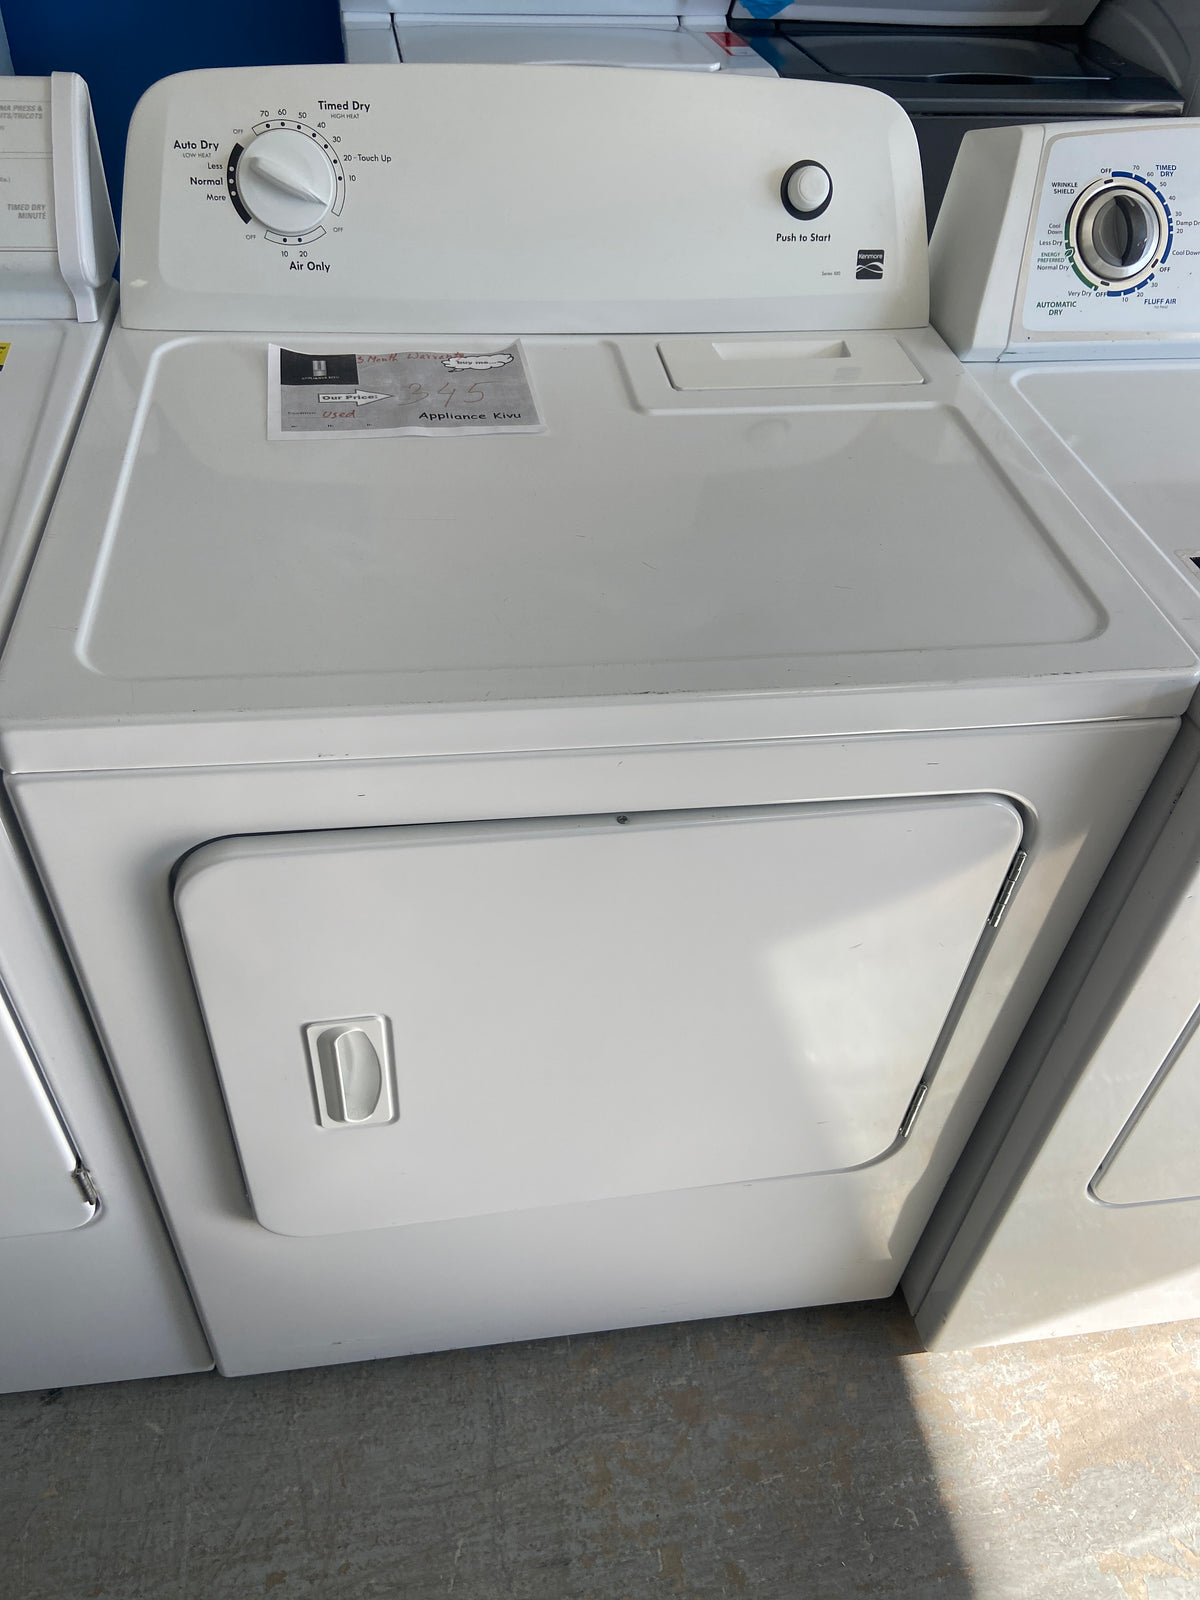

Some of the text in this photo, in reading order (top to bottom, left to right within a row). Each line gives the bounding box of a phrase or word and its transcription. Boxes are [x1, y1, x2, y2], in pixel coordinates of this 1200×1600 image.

[317, 101, 371, 113] Timed Dry
[173, 140, 220, 152] Auto Dry
[357, 154, 380, 162] Touch
[381, 155, 392, 163] Up
[190, 177, 224, 186] Normal
[206, 194, 227, 202] More
[7, 203, 30, 211] TIMED
[776, 233, 831, 242] Push to Start
[289, 262, 331, 273] Air Only
[1036, 301, 1077, 309] AUTOMATIC
[367, 353, 398, 363] Month
[419, 411, 486, 421] Appliance
